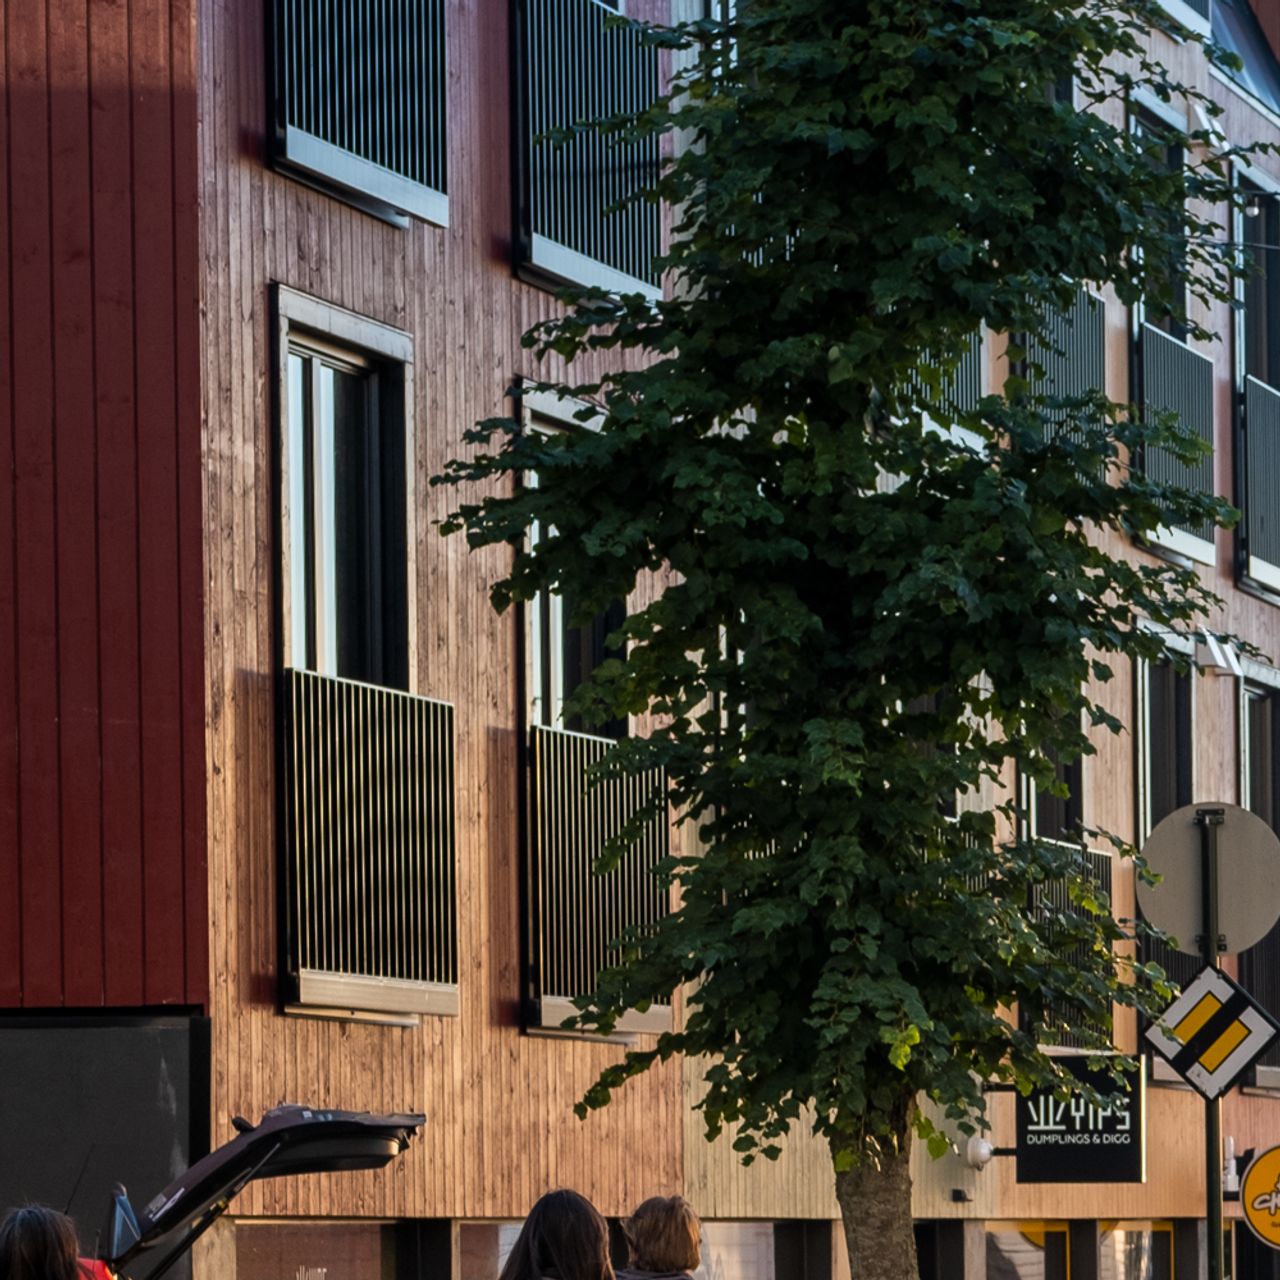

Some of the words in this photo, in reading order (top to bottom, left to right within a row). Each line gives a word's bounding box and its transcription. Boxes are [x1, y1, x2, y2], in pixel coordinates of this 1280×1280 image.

[1027, 1133, 1090, 1144] DUMPLINGS
[1093, 1134, 1101, 1143] &
[1103, 1133, 1131, 1144] DIGG
